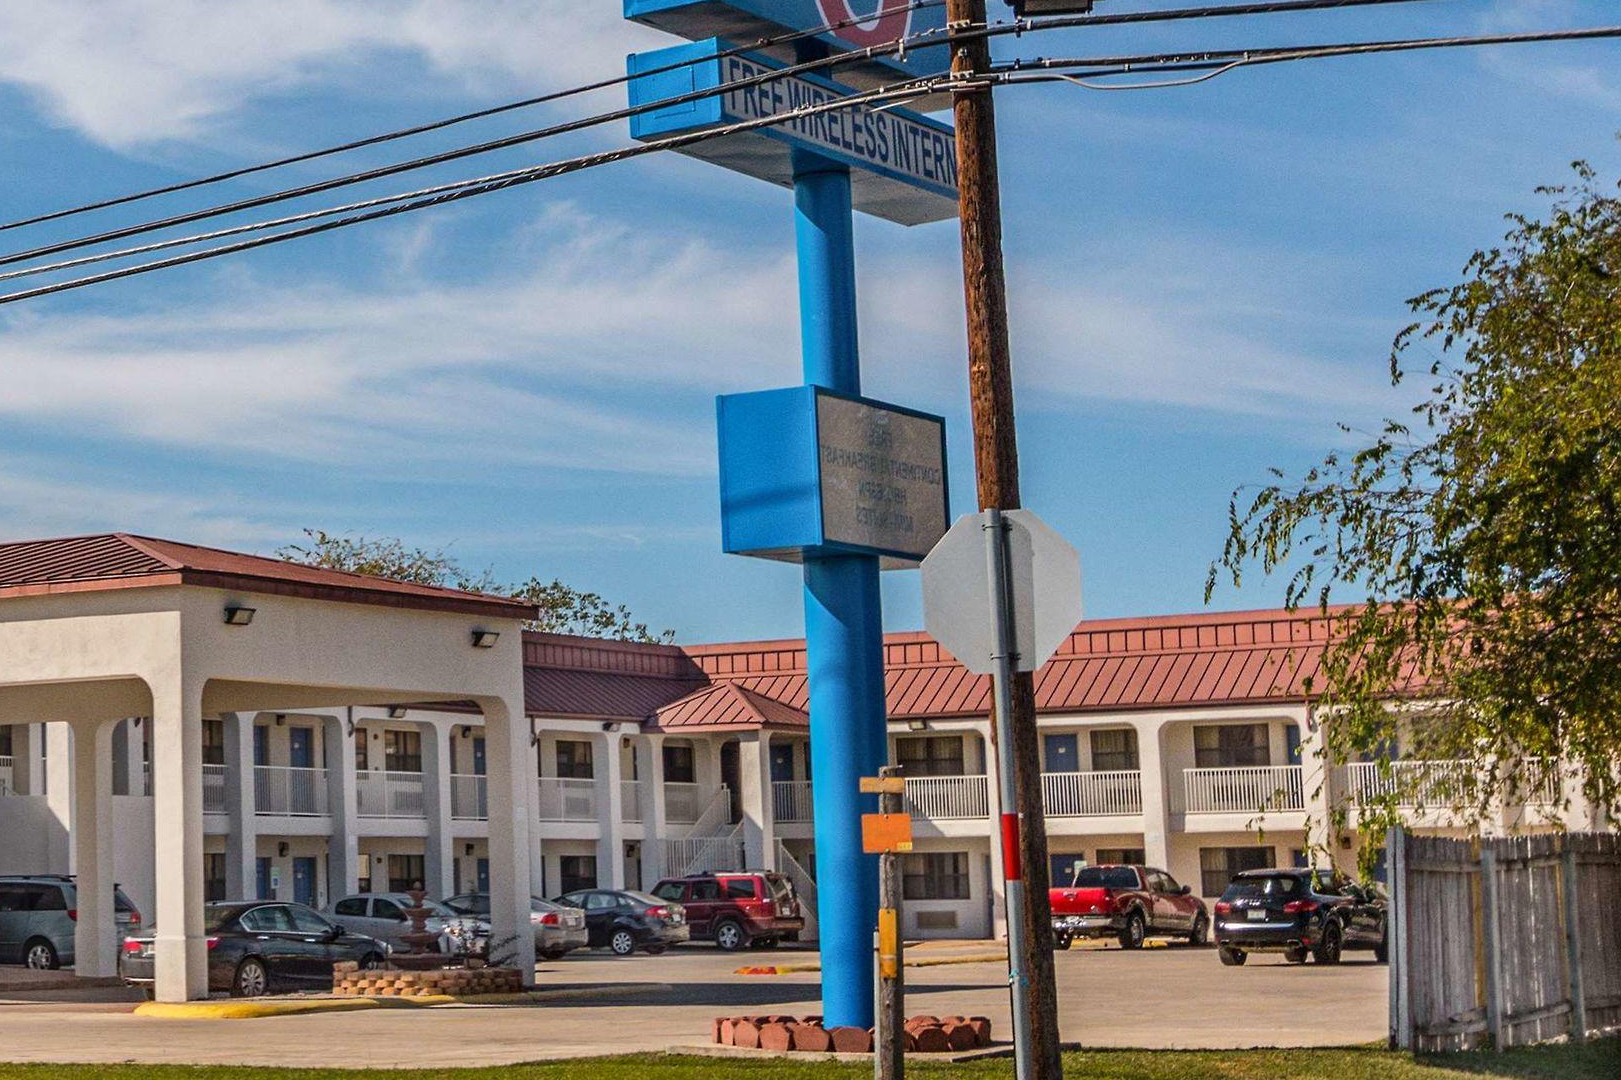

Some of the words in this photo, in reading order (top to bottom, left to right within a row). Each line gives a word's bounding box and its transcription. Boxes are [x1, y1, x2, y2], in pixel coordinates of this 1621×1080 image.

[729, 57, 785, 126] FREE
[787, 78, 889, 163] WIRELESS
[892, 123, 958, 187] INTERN
